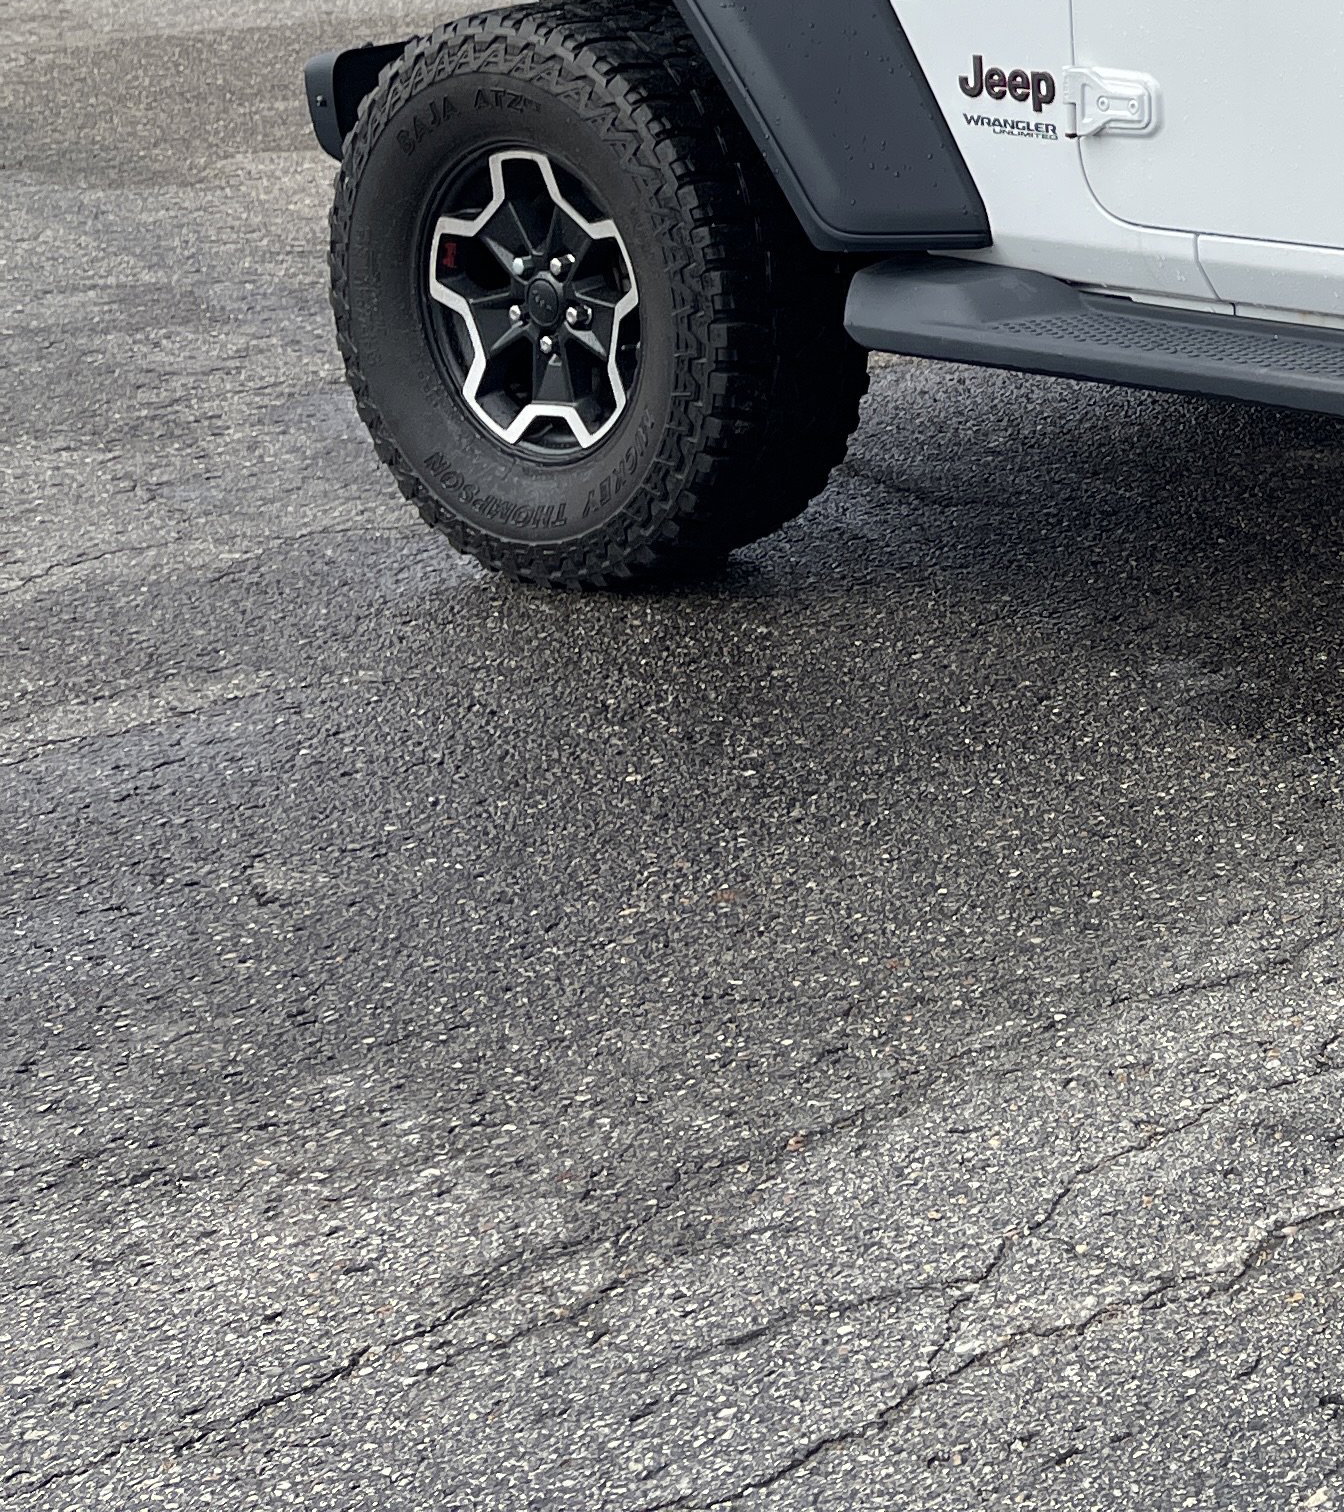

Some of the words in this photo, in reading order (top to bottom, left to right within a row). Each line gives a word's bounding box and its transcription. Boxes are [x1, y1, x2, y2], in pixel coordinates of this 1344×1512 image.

[958, 54, 1056, 113] Jeep
[962, 112, 1058, 135] WRANGLER
[992, 128, 1059, 141] UNLIMITED
[423, 451, 568, 528] THOMPSON
